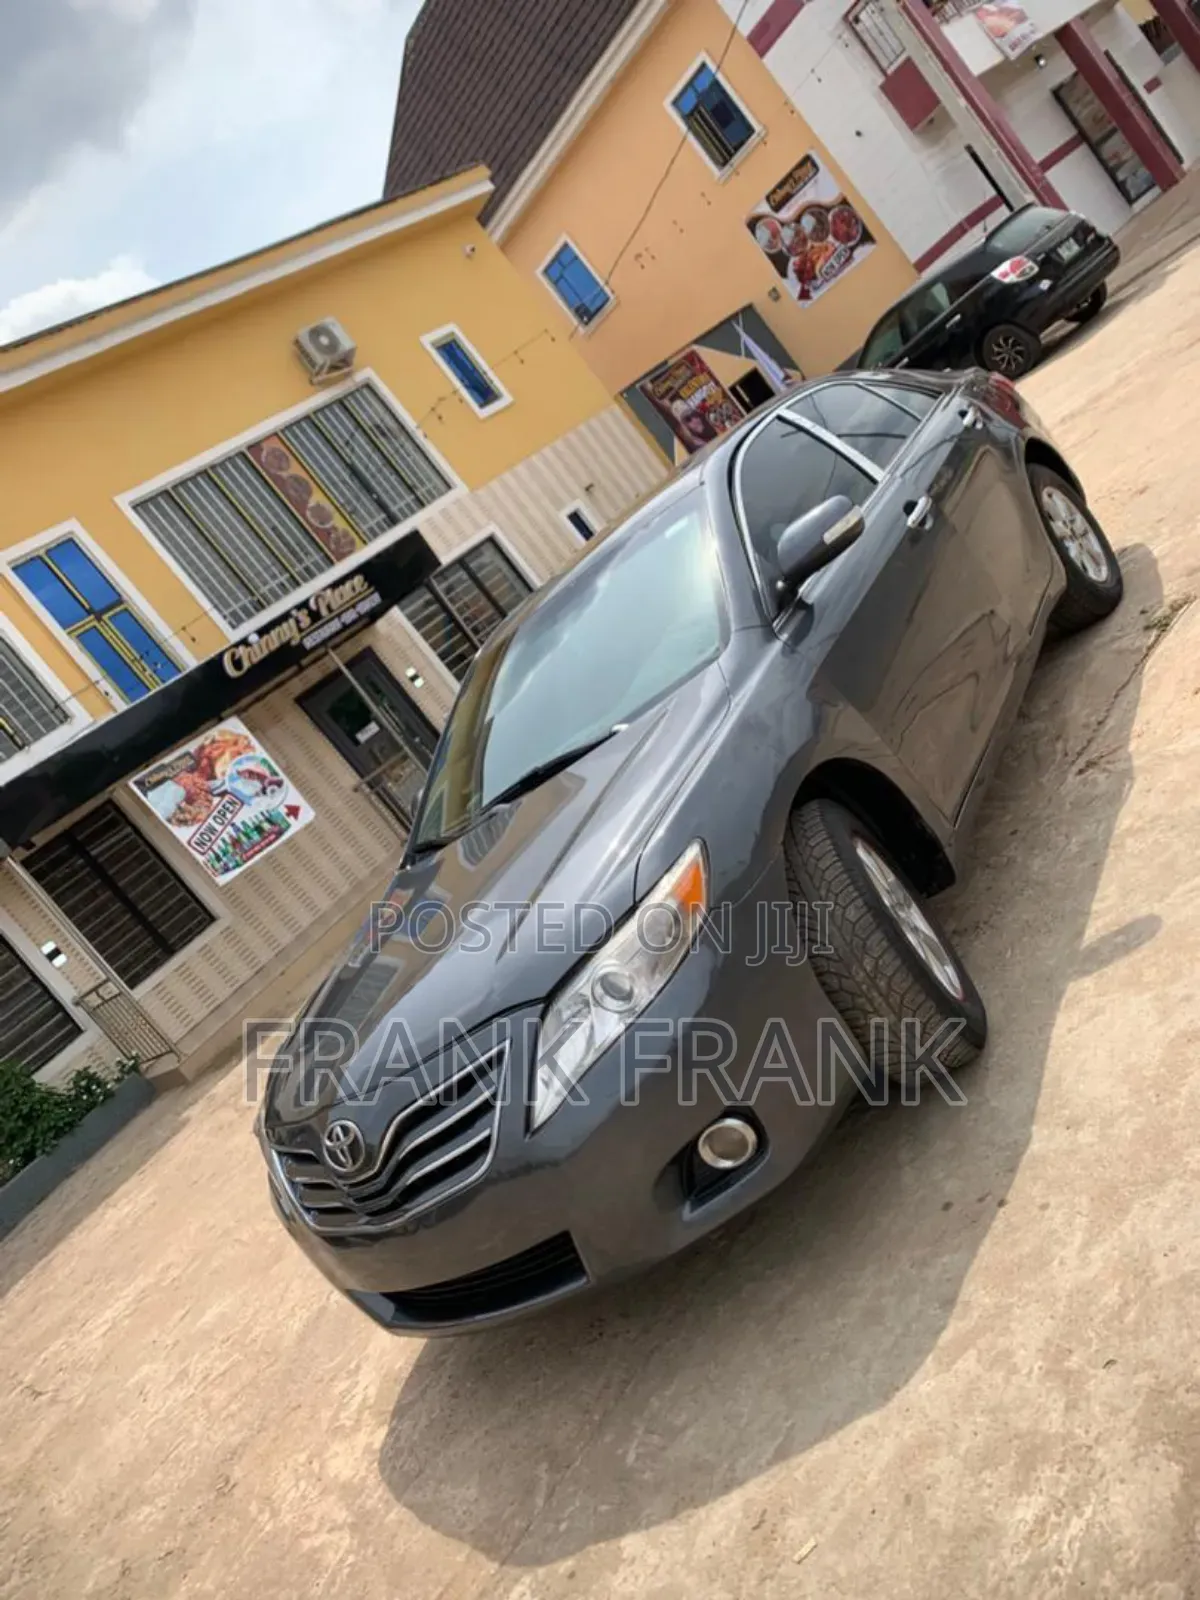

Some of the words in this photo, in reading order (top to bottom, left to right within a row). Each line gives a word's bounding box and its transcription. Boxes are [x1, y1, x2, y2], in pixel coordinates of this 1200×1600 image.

[223, 607, 311, 678] Chinny's
[309, 574, 368, 617] Place
[193, 821, 219, 850] NOW
[212, 797, 238, 827] OPEN
